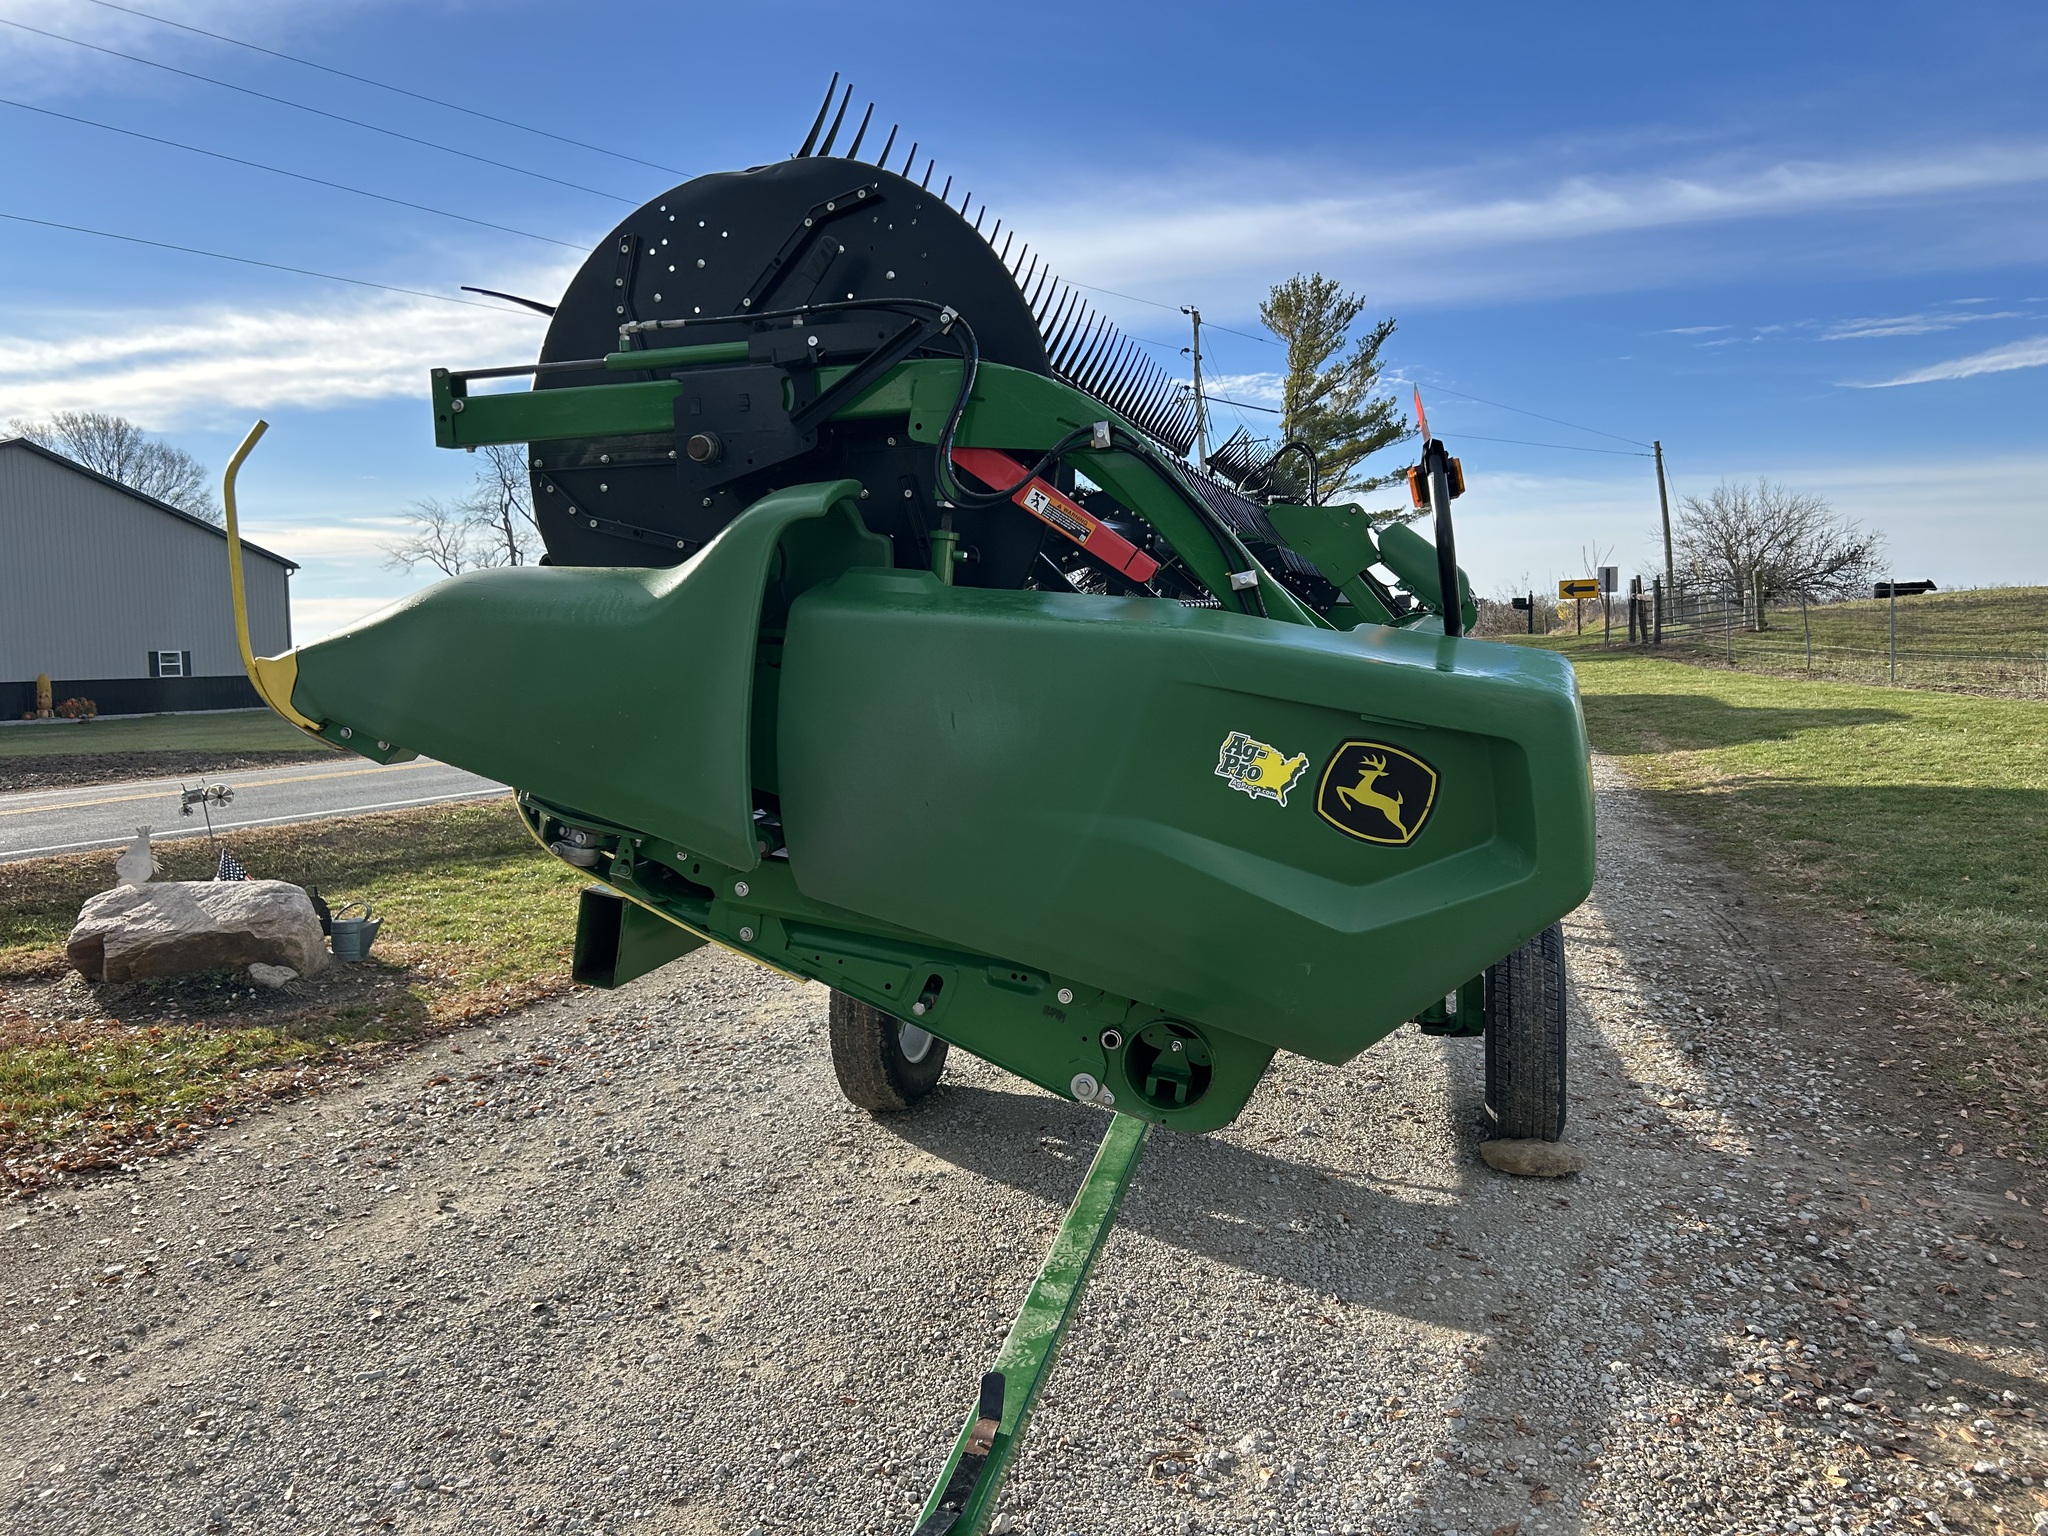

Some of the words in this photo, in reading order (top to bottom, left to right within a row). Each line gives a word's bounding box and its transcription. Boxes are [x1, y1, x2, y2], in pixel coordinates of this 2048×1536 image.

[1063, 506, 1088, 526] WARNING
[1224, 735, 1267, 762] Ag-
[1219, 755, 1262, 781] Pro
[1231, 779, 1277, 798] AgProCo.com
